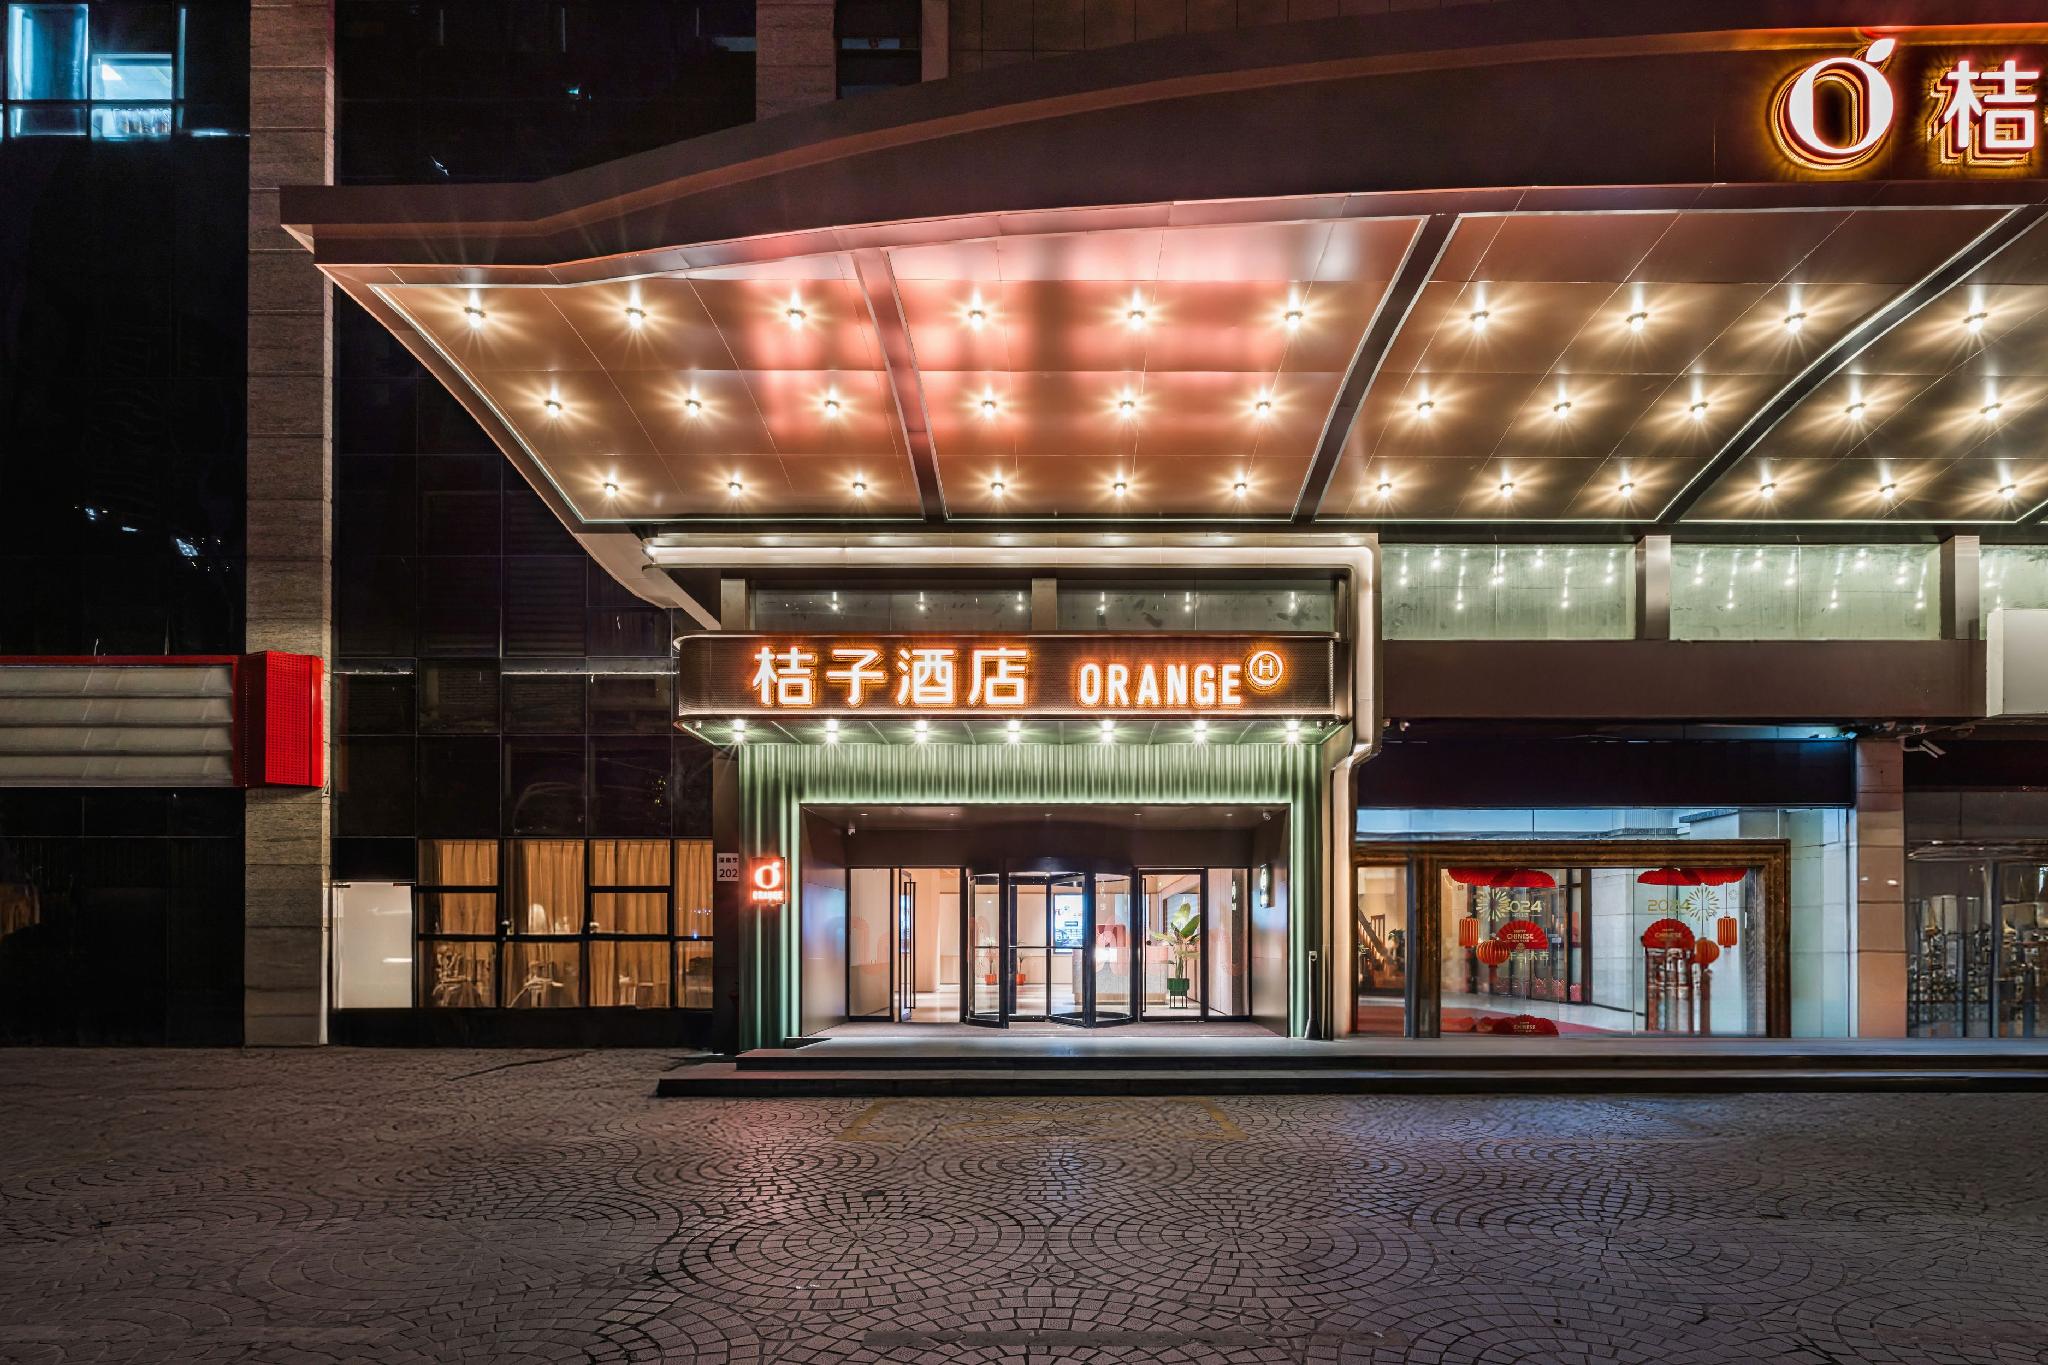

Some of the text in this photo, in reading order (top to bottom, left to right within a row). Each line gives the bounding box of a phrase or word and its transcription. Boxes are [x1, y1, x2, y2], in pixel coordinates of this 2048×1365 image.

[1942, 60, 2040, 148] 桔
[752, 646, 1028, 705] 桔子酒店
[1079, 663, 1242, 705] ORANGE
[719, 868, 738, 878] 202
